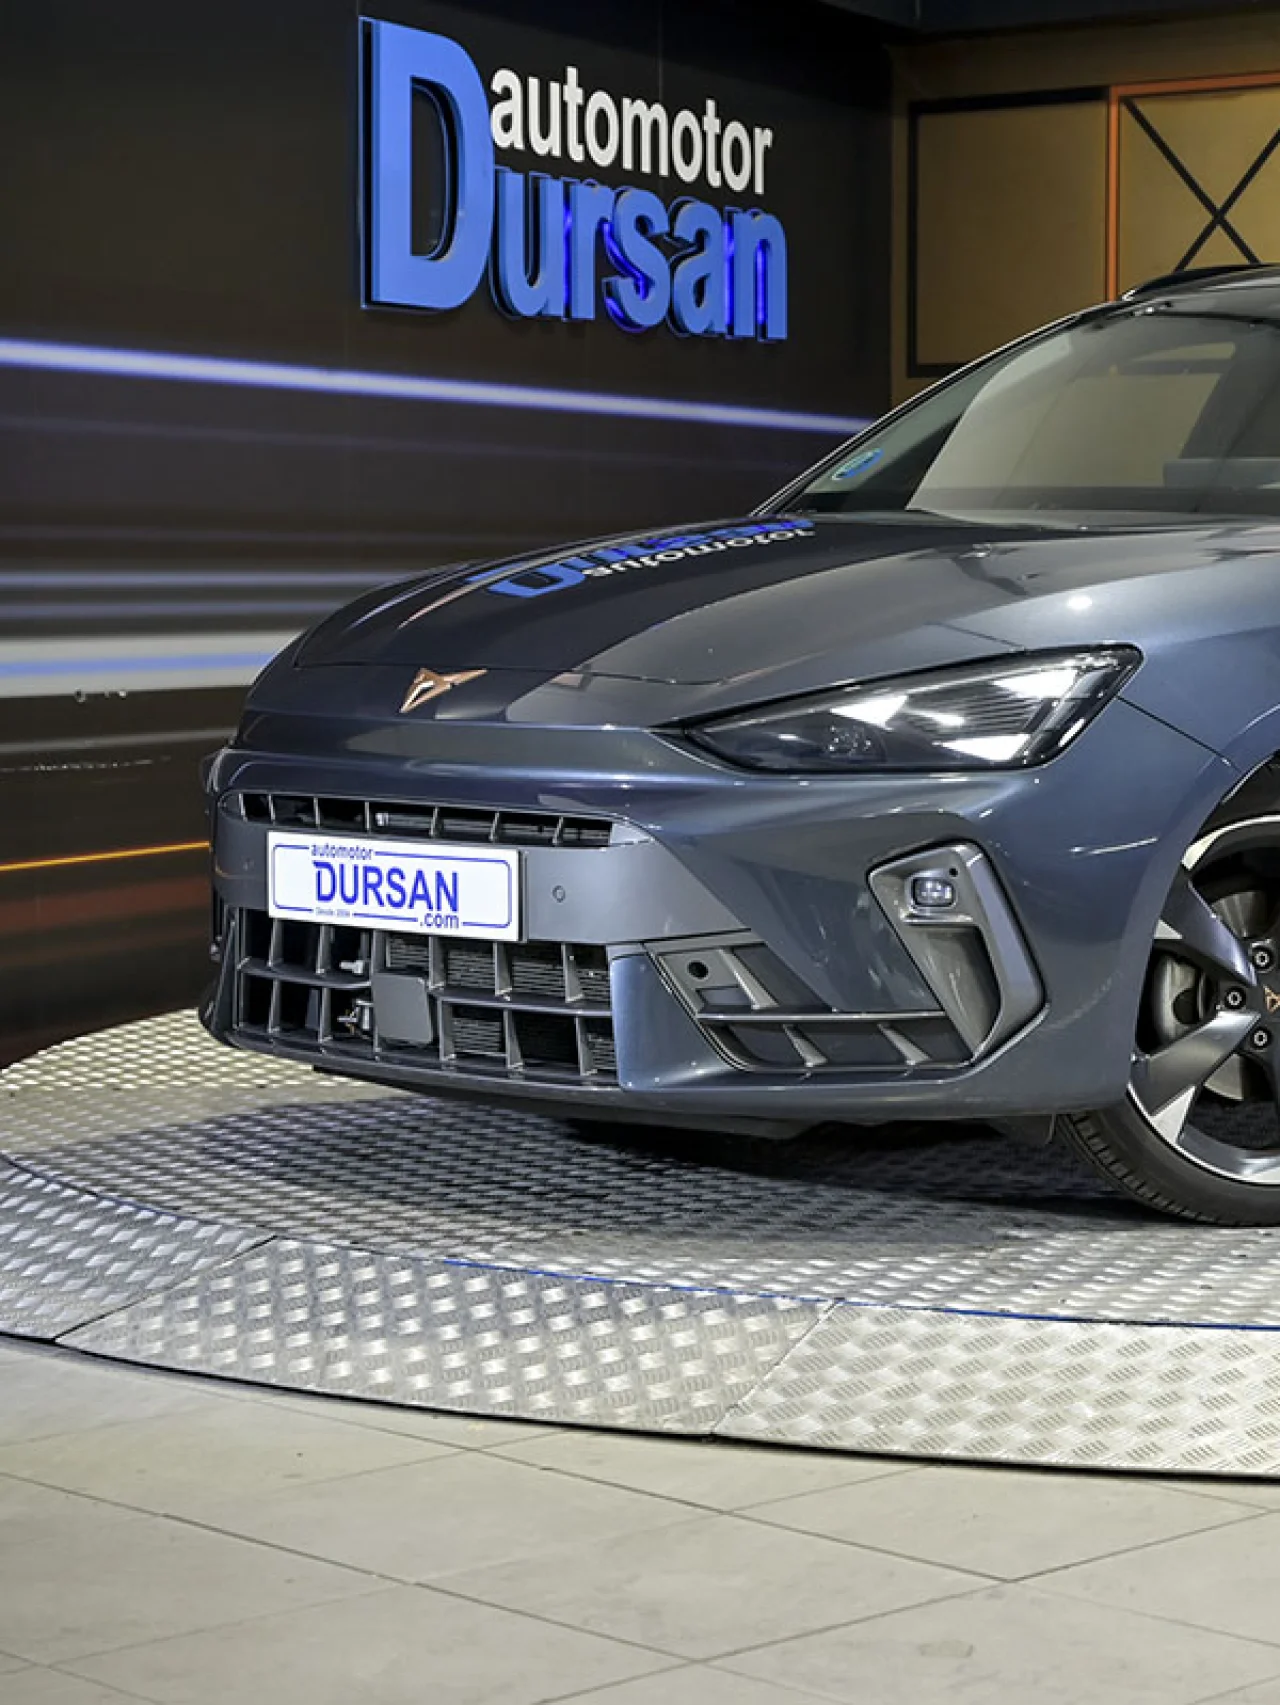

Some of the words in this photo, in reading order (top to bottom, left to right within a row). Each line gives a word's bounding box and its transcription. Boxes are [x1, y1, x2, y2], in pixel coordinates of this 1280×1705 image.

[490, 65, 773, 195] automotor
[358, 15, 788, 341] Dursan
[311, 843, 373, 860] automotor
[312, 860, 459, 912] DURSAN
[420, 913, 459, 929] .com
